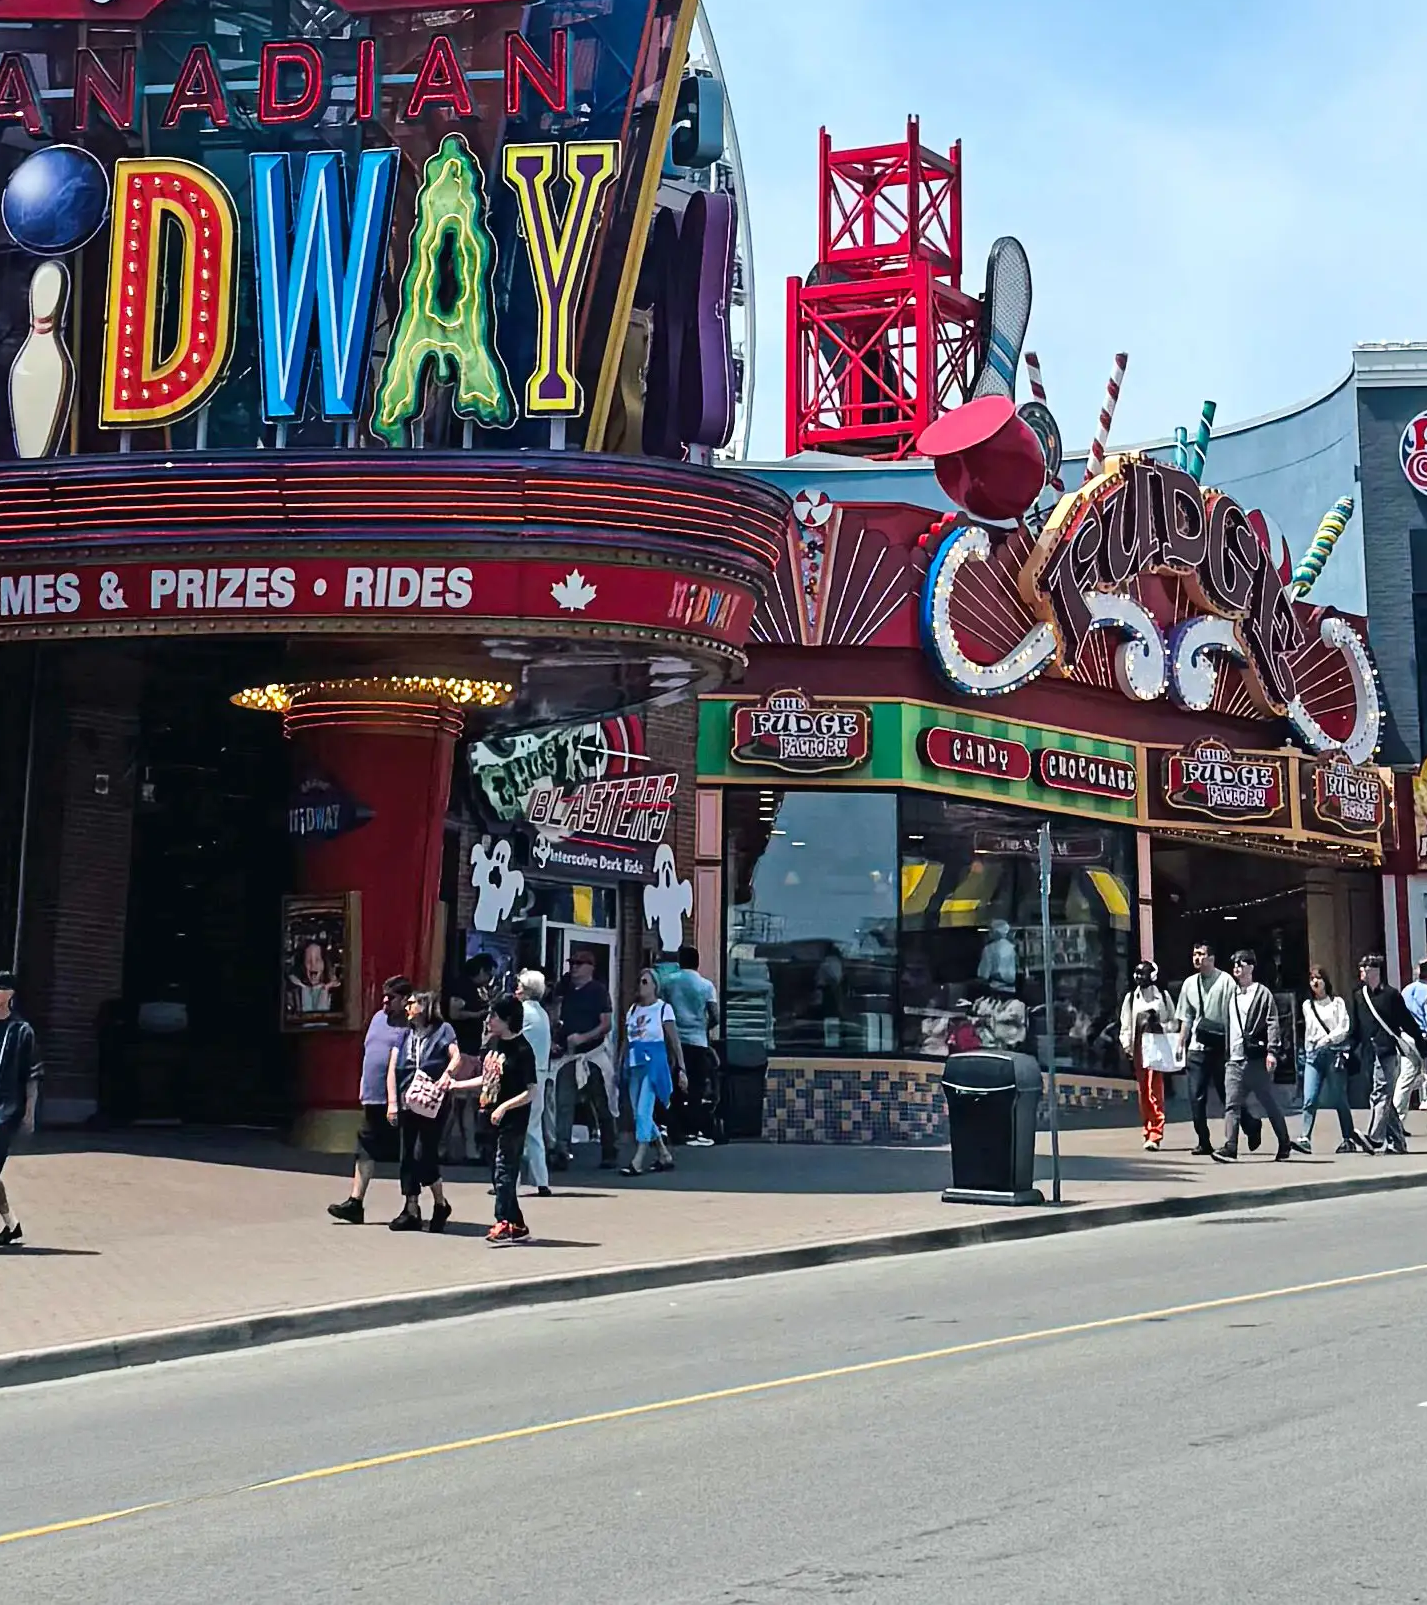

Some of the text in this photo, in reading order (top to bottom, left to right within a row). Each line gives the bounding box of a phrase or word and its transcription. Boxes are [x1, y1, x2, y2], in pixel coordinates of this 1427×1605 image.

[99, 572, 128, 609] &
[151, 567, 295, 610] PRIZES
[345, 566, 473, 608] RIDES
[1038, 461, 1305, 702] FUDGE
[752, 711, 858, 736] FUDGE
[953, 739, 1009, 770] CANDY
[1049, 754, 1135, 790] CHOCOLATE
[1182, 761, 1273, 787] FUDGE
[1325, 774, 1379, 803] FUDGE
[529, 774, 679, 843] BLASTERS
[550, 849, 643, 874] Interactive Dark Ride
